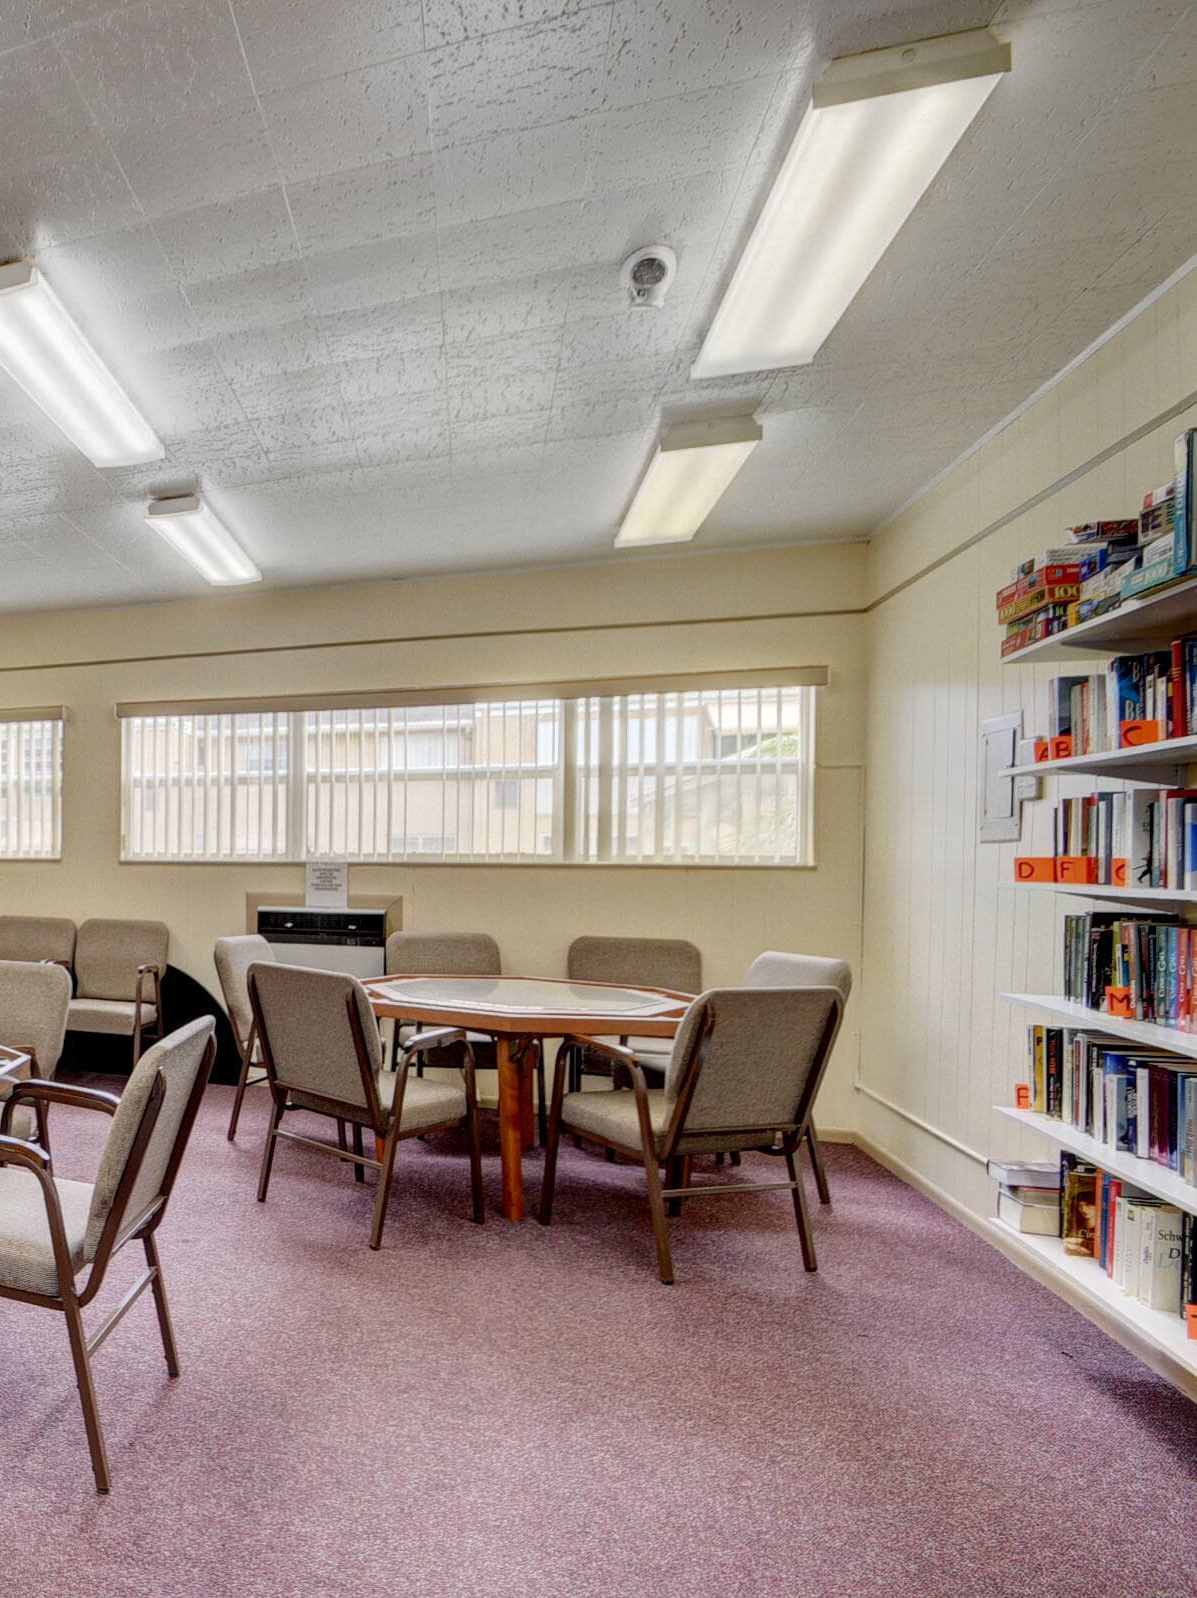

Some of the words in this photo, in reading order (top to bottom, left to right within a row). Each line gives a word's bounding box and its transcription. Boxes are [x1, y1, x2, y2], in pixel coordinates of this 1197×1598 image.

[1123, 725, 1142, 746] C
[1055, 741, 1071, 757] B
[1018, 861, 1035, 879] D
[1060, 861, 1074, 878] F
[1109, 993, 1130, 1011] M
